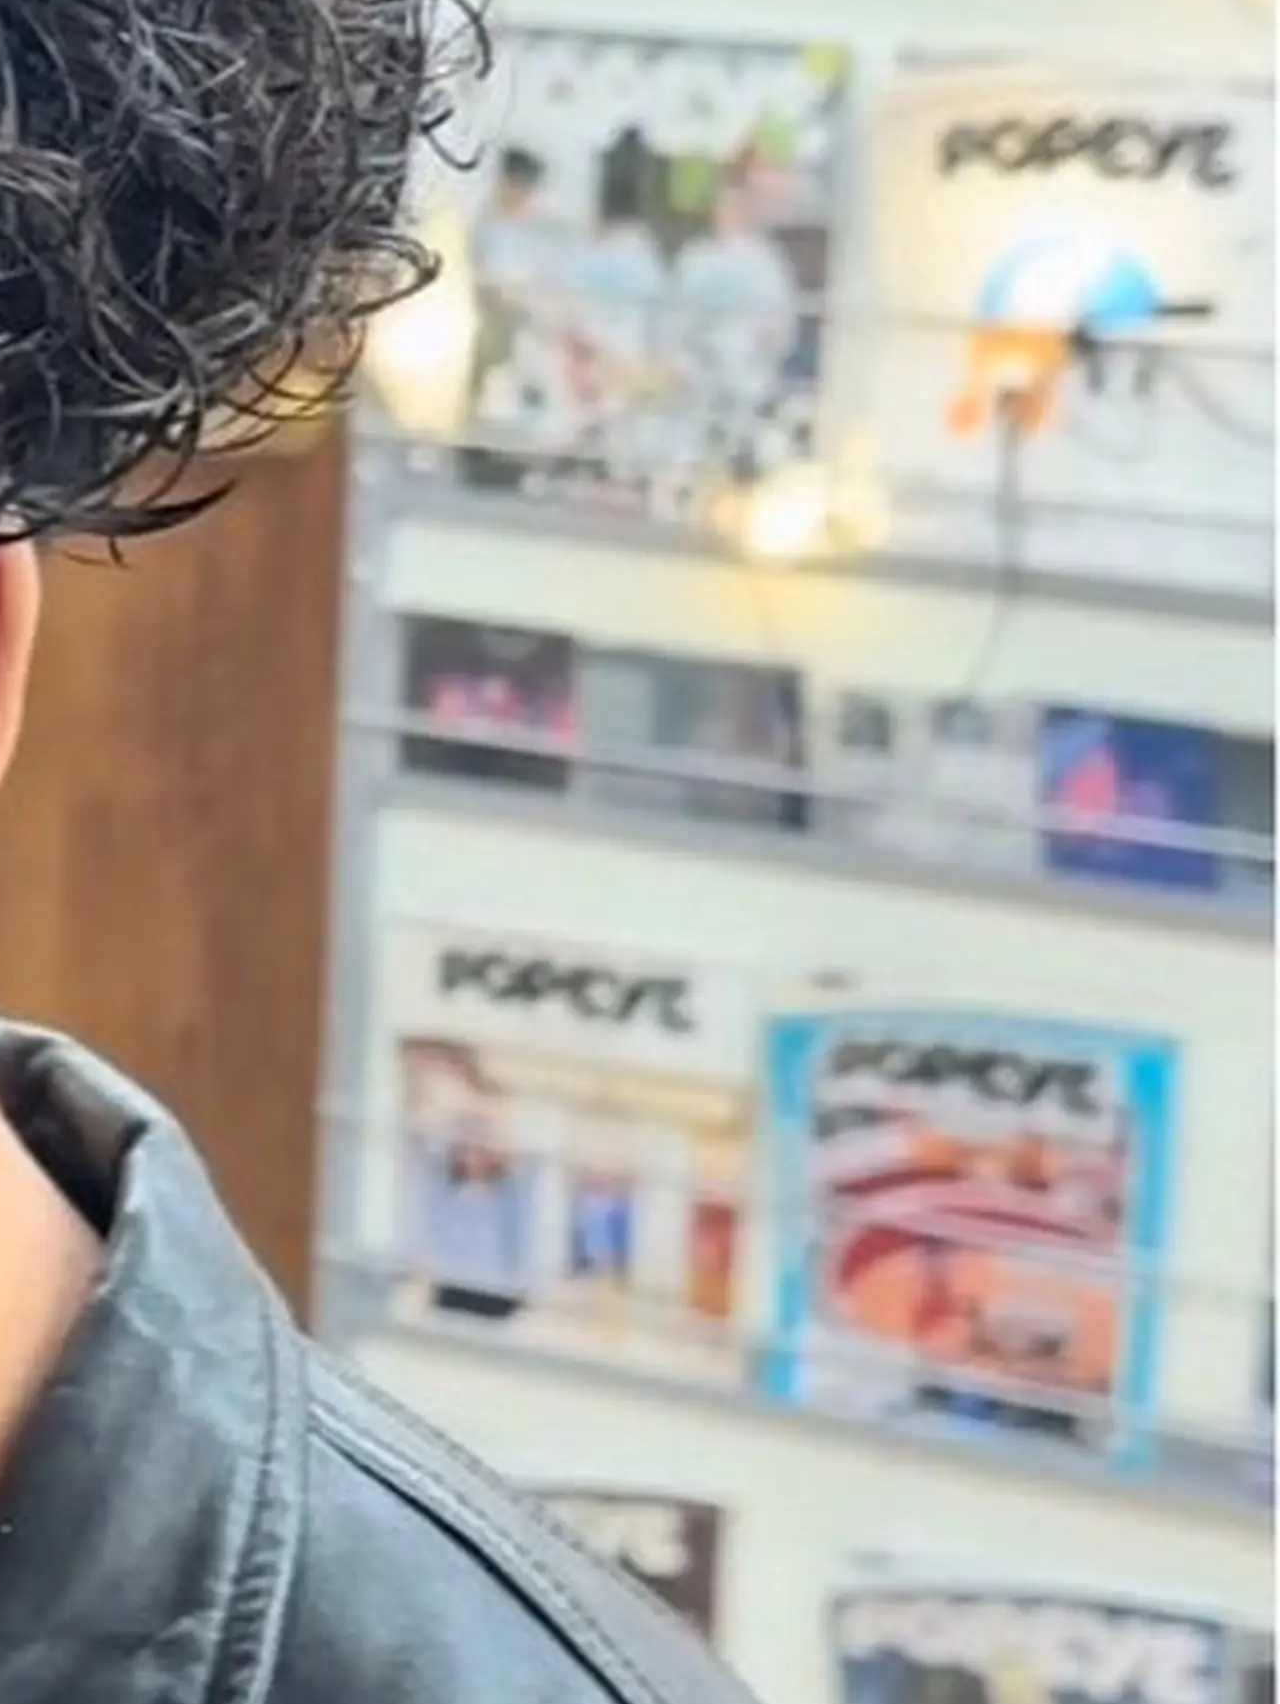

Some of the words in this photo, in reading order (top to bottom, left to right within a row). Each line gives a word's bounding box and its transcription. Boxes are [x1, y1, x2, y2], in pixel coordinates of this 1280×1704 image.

[937, 114, 1240, 188] POPEYE
[436, 947, 695, 1033] POPEYE
[833, 1042, 1102, 1118] POPEYE
